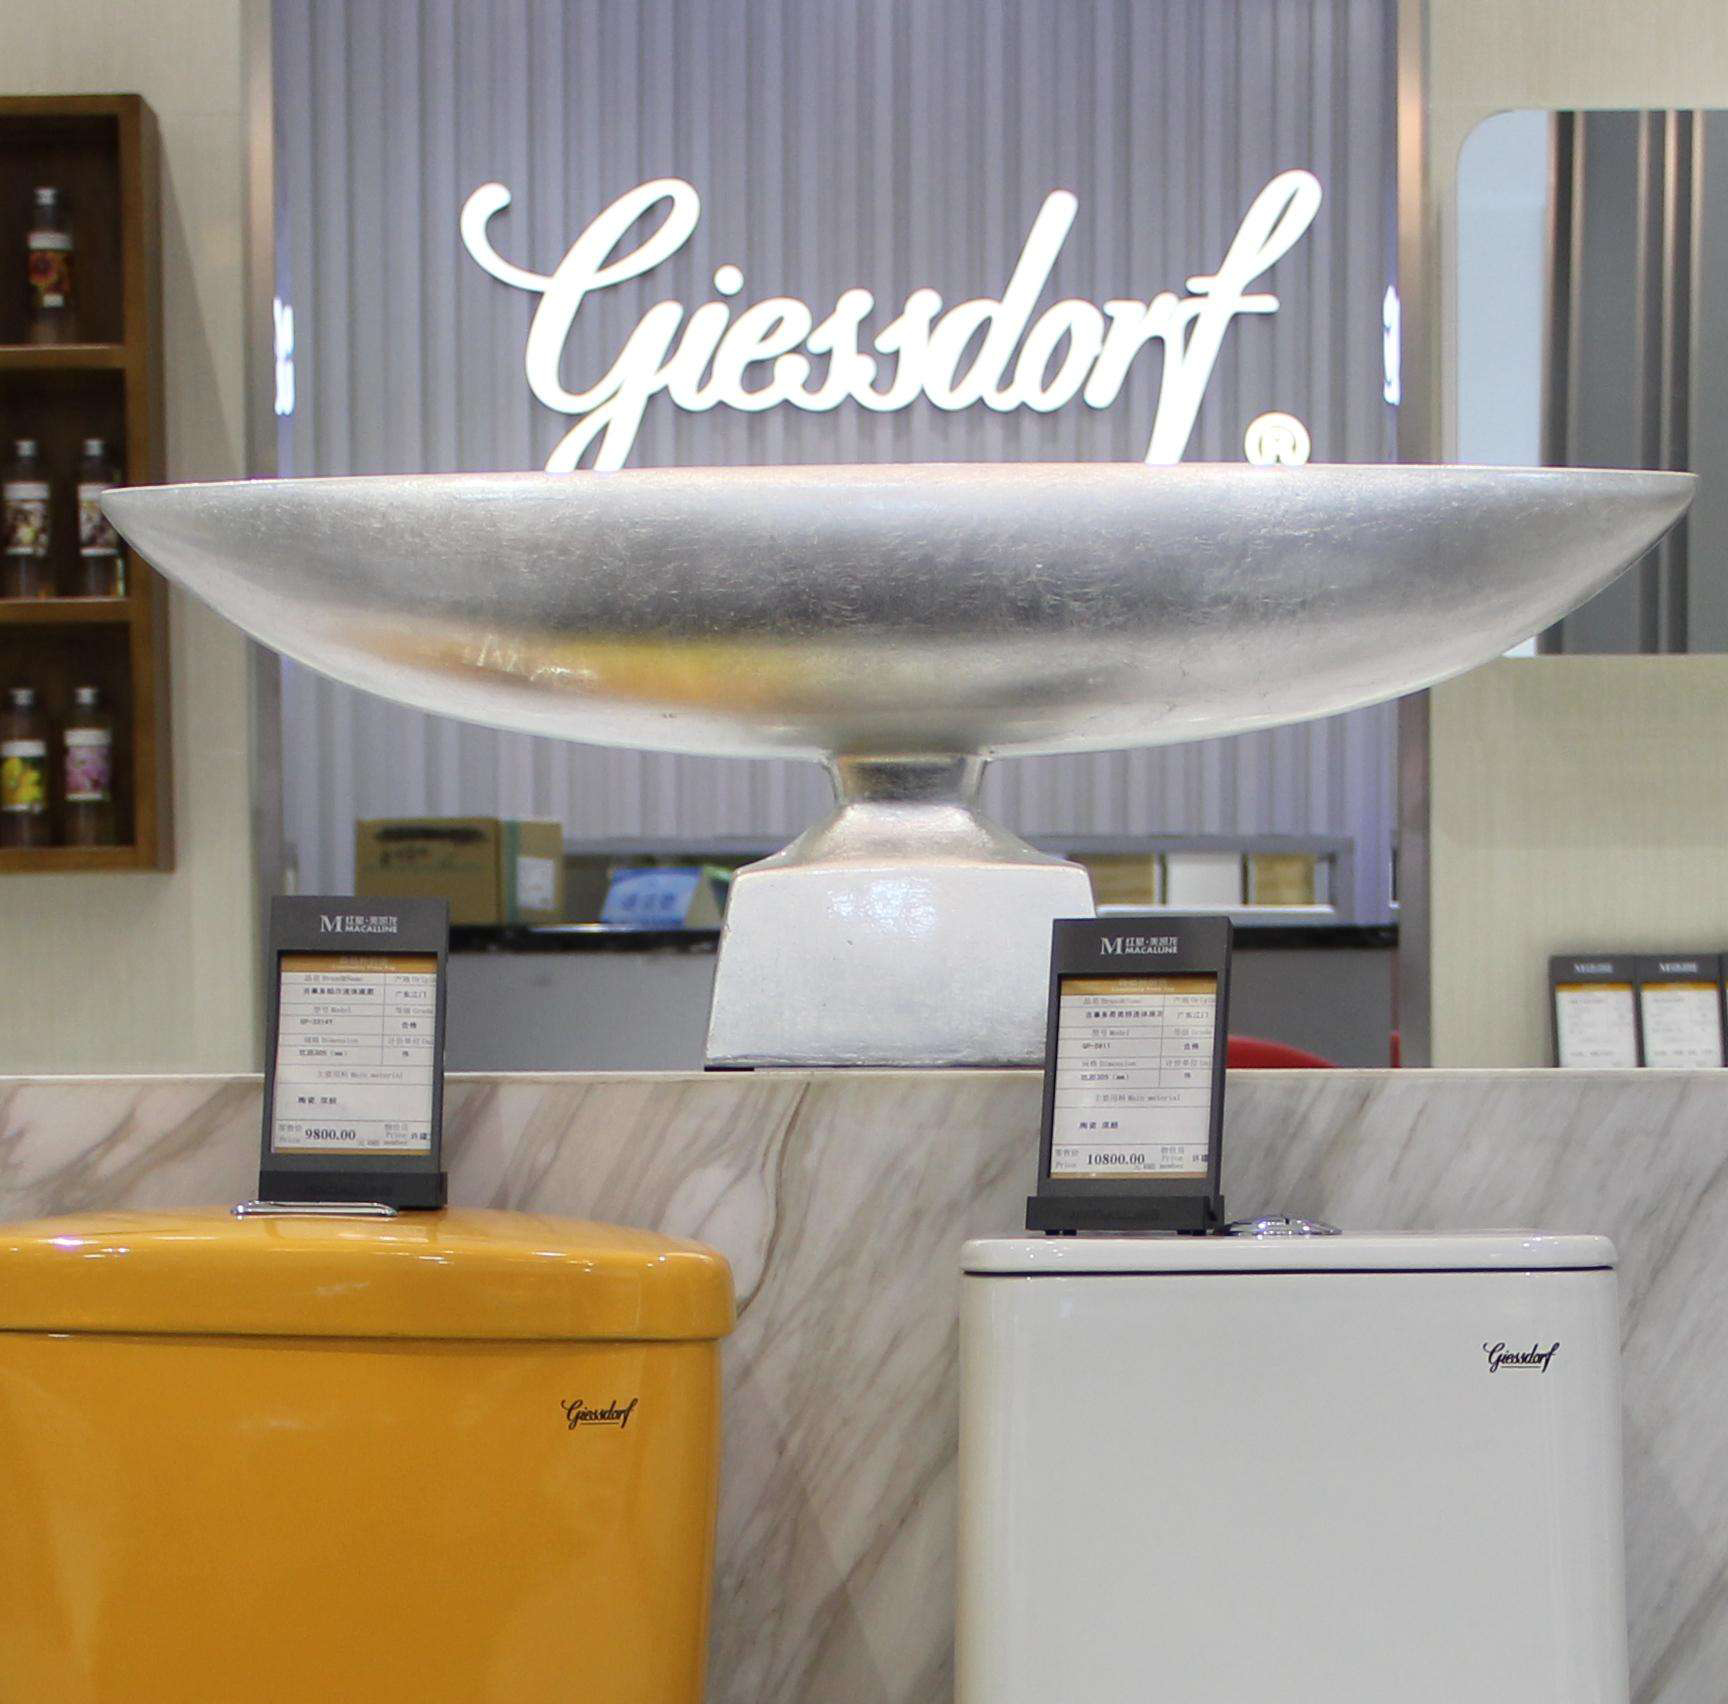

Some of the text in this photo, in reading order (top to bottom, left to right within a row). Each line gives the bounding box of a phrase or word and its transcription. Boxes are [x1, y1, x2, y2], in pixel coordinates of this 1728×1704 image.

[460, 169, 1322, 472] Giessdorf
[305, 1128, 356, 1140] 9800.00
[1088, 1153, 1145, 1165] 10800.00
[1483, 1342, 1560, 1373] Giessdorf
